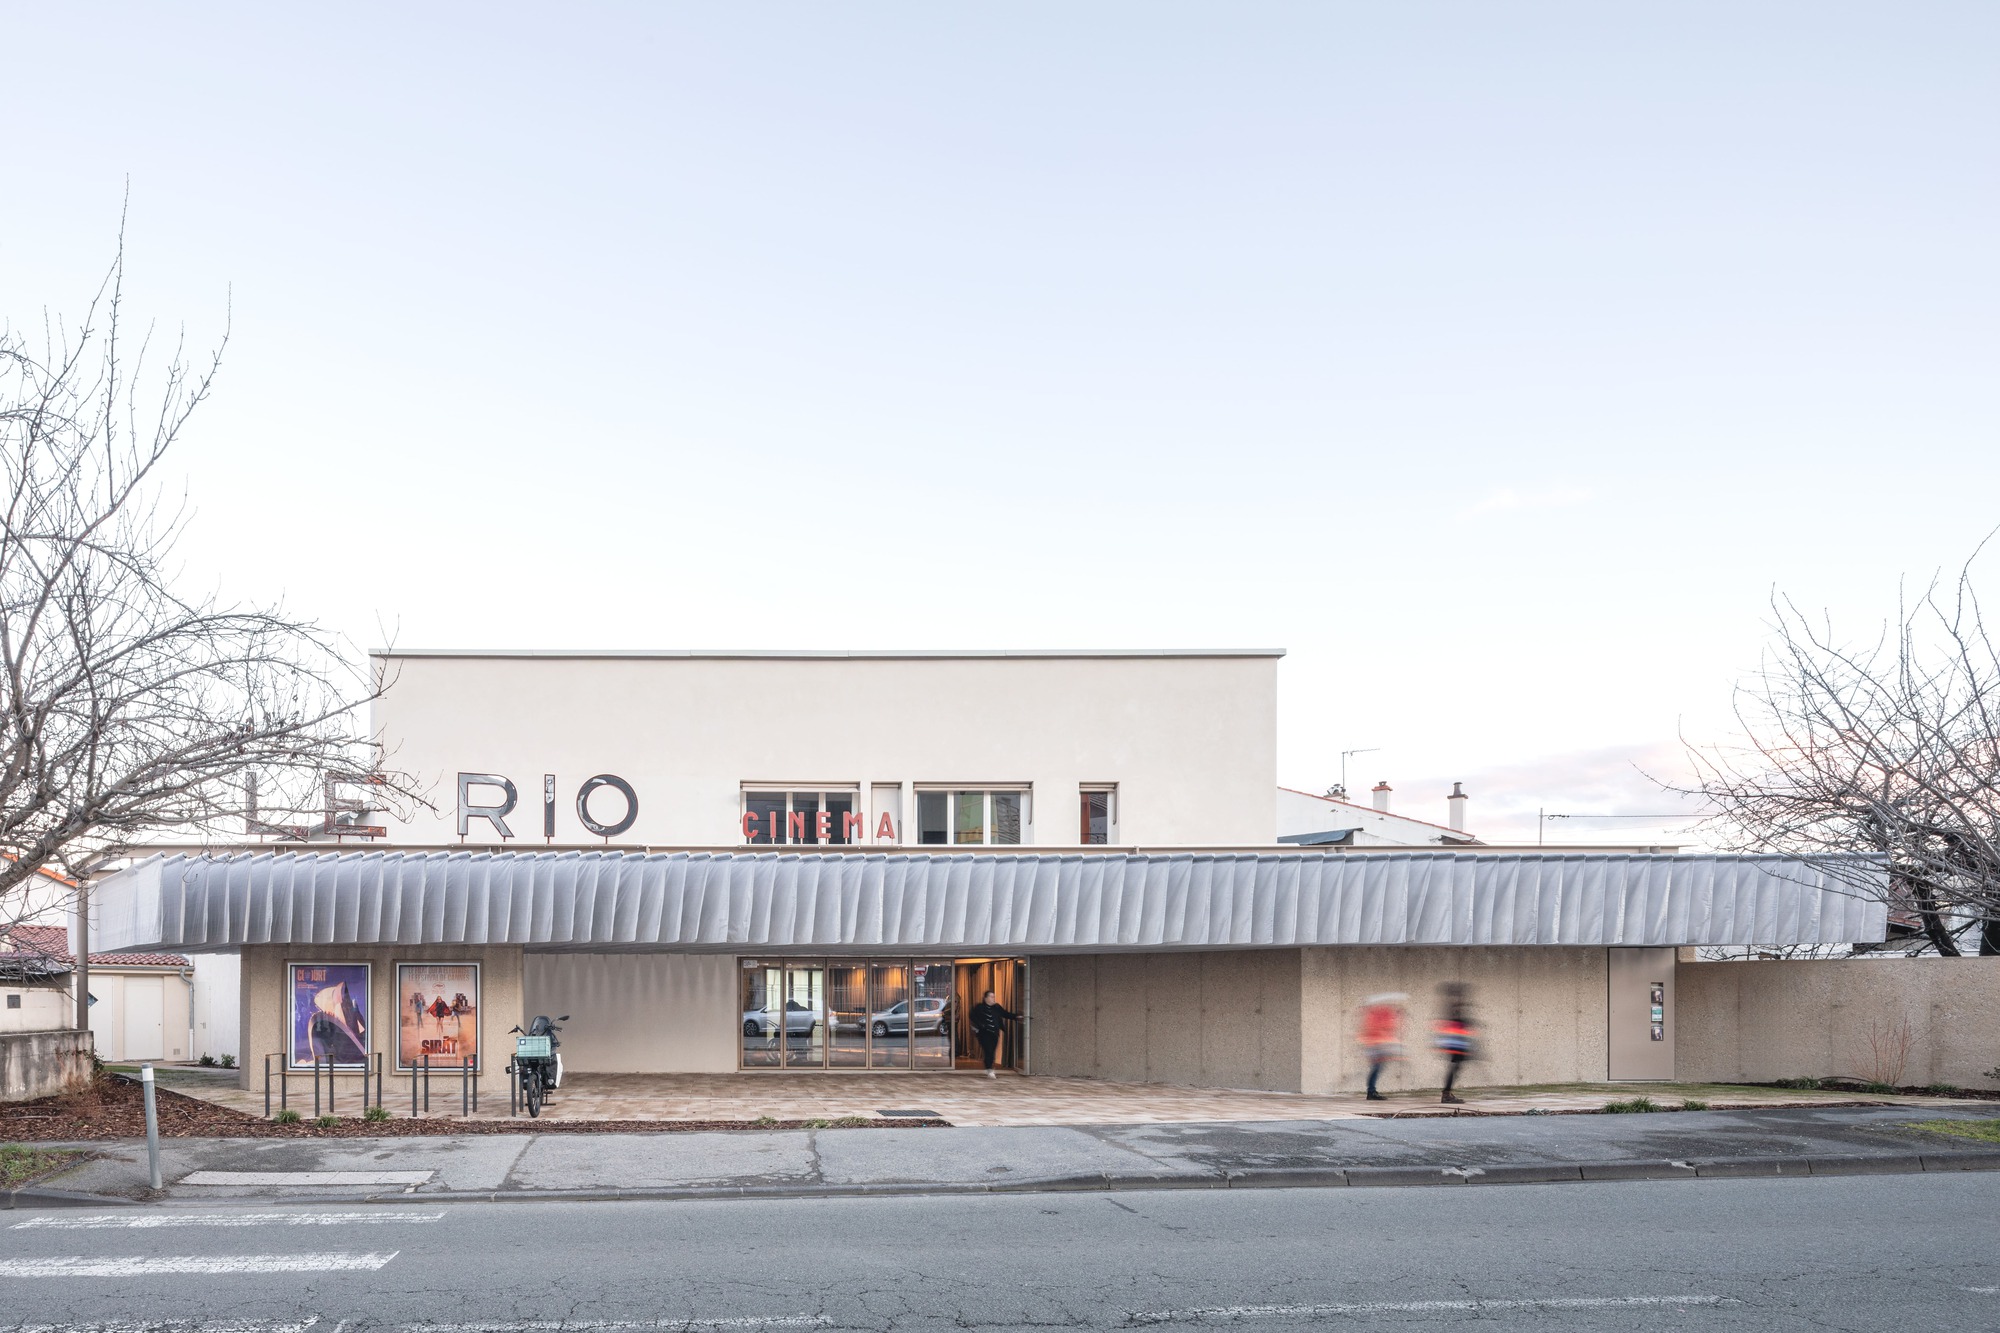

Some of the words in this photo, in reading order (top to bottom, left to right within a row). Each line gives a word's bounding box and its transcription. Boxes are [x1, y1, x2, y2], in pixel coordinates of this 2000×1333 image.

[246, 771, 386, 837] LE
[457, 771, 639, 837] RIO
[742, 811, 895, 839] CINEMA
